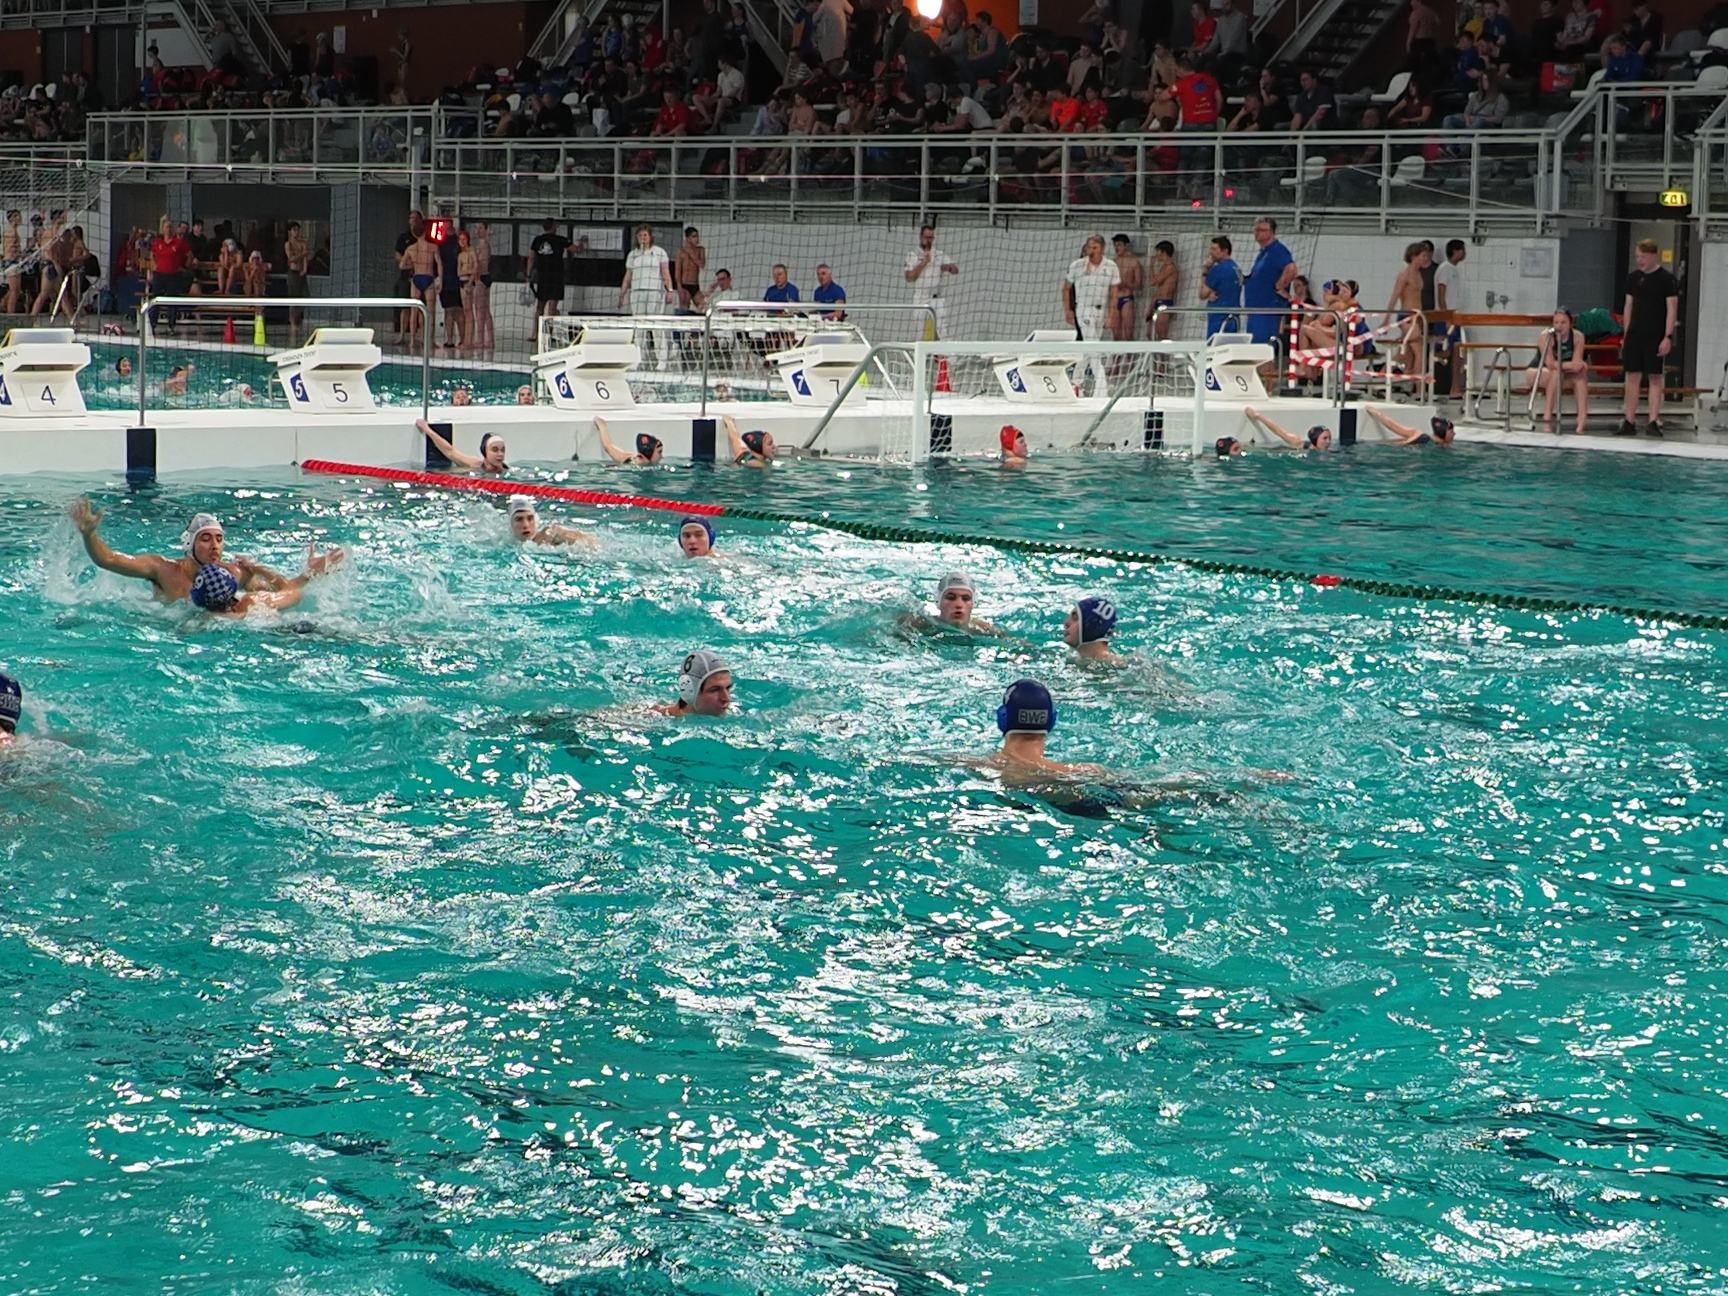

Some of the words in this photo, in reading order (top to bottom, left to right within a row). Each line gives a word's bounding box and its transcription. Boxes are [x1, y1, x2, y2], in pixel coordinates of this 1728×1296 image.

[294, 379, 304, 399] 5
[332, 383, 348, 403] 5
[559, 376, 568, 396] 6
[595, 380, 610, 401] 6
[796, 375, 805, 392] 7
[828, 379, 840, 397] 7
[1042, 376, 1057, 394] 8
[1235, 375, 1248, 392] 9
[41, 385, 56, 406] 4
[1092, 600, 1114, 621] 10
[683, 654, 696, 674] 6
